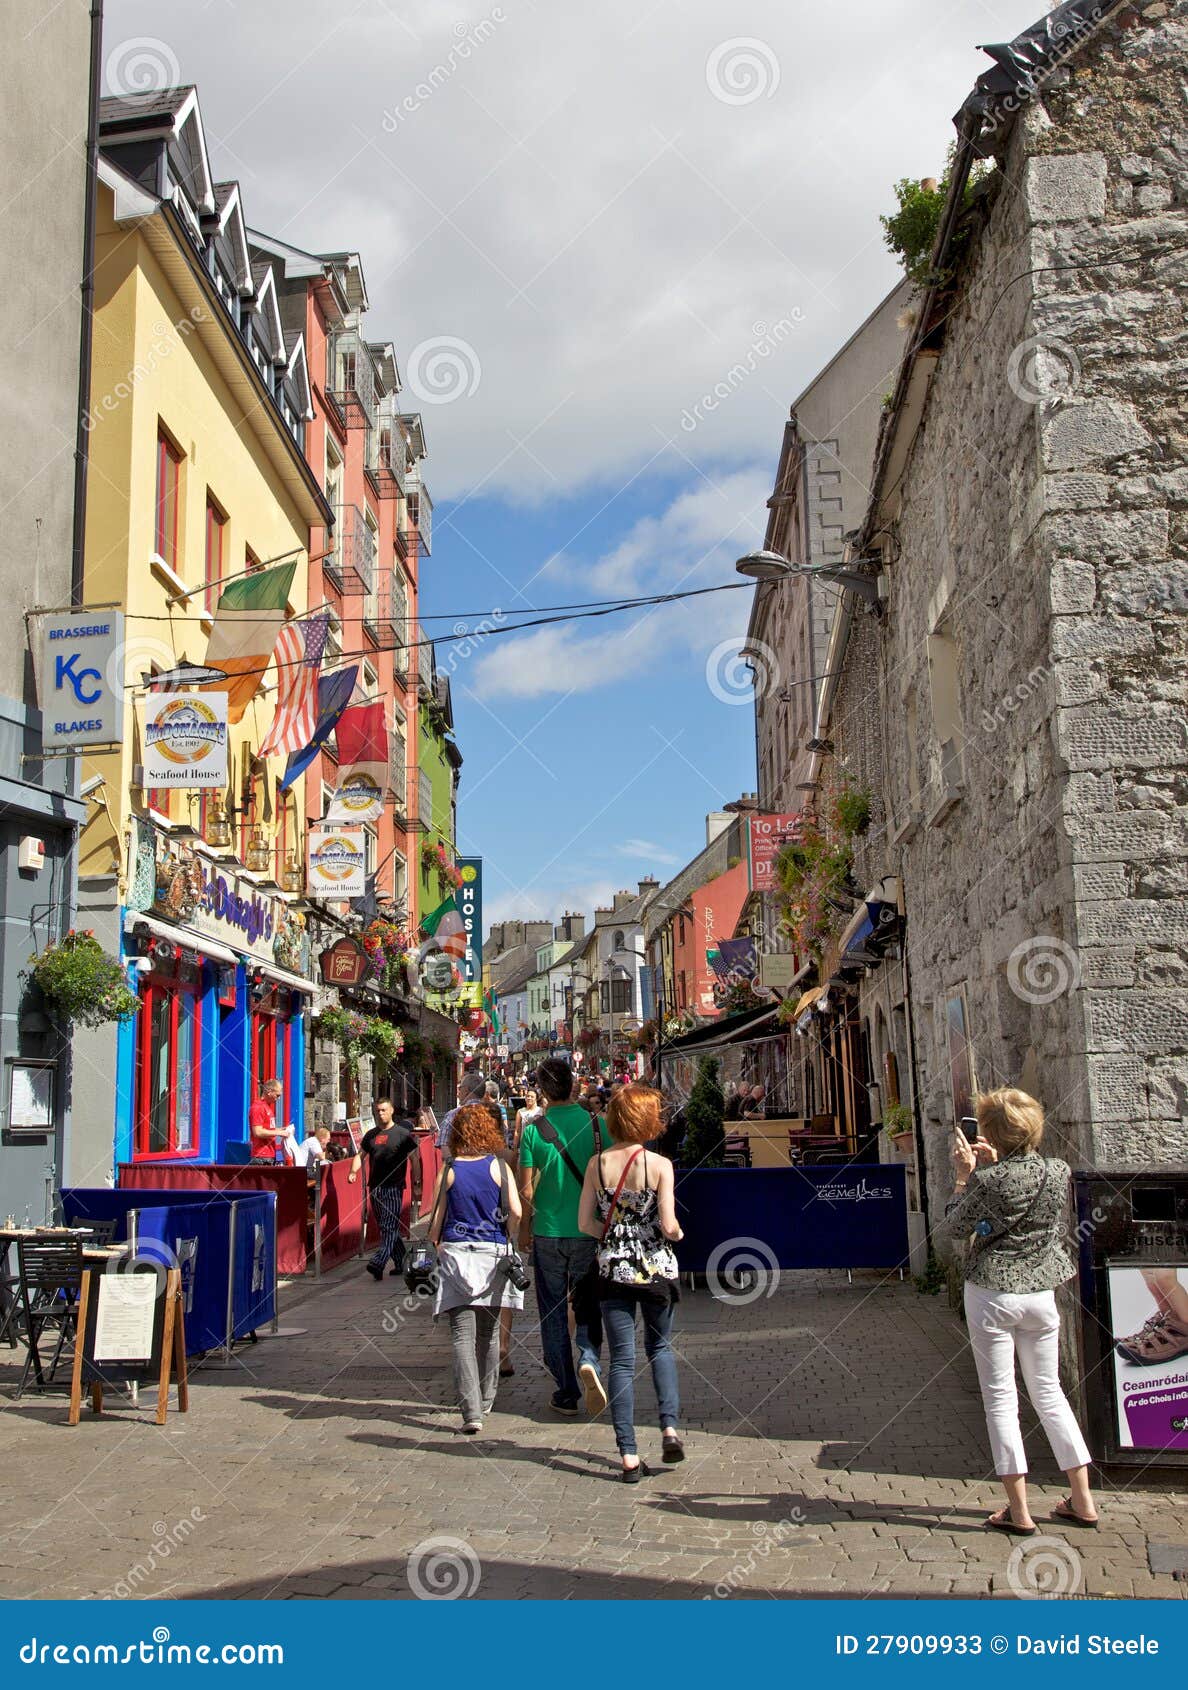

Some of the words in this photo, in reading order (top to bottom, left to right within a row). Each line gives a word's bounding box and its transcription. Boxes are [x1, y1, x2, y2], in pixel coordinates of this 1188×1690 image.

[49, 624, 110, 639] BRASSERIE
[55, 653, 102, 704] KC
[55, 719, 102, 733] BLAKES
[149, 769, 188, 779] Seafood
[191, 768, 221, 779] House
[752, 820, 771, 834] To
[462, 887, 475, 977] HOSTEL
[1127, 1400, 1138, 1408] Ar
[1138, 1398, 1149, 1406] do
[1149, 1394, 1172, 1404] Chois
